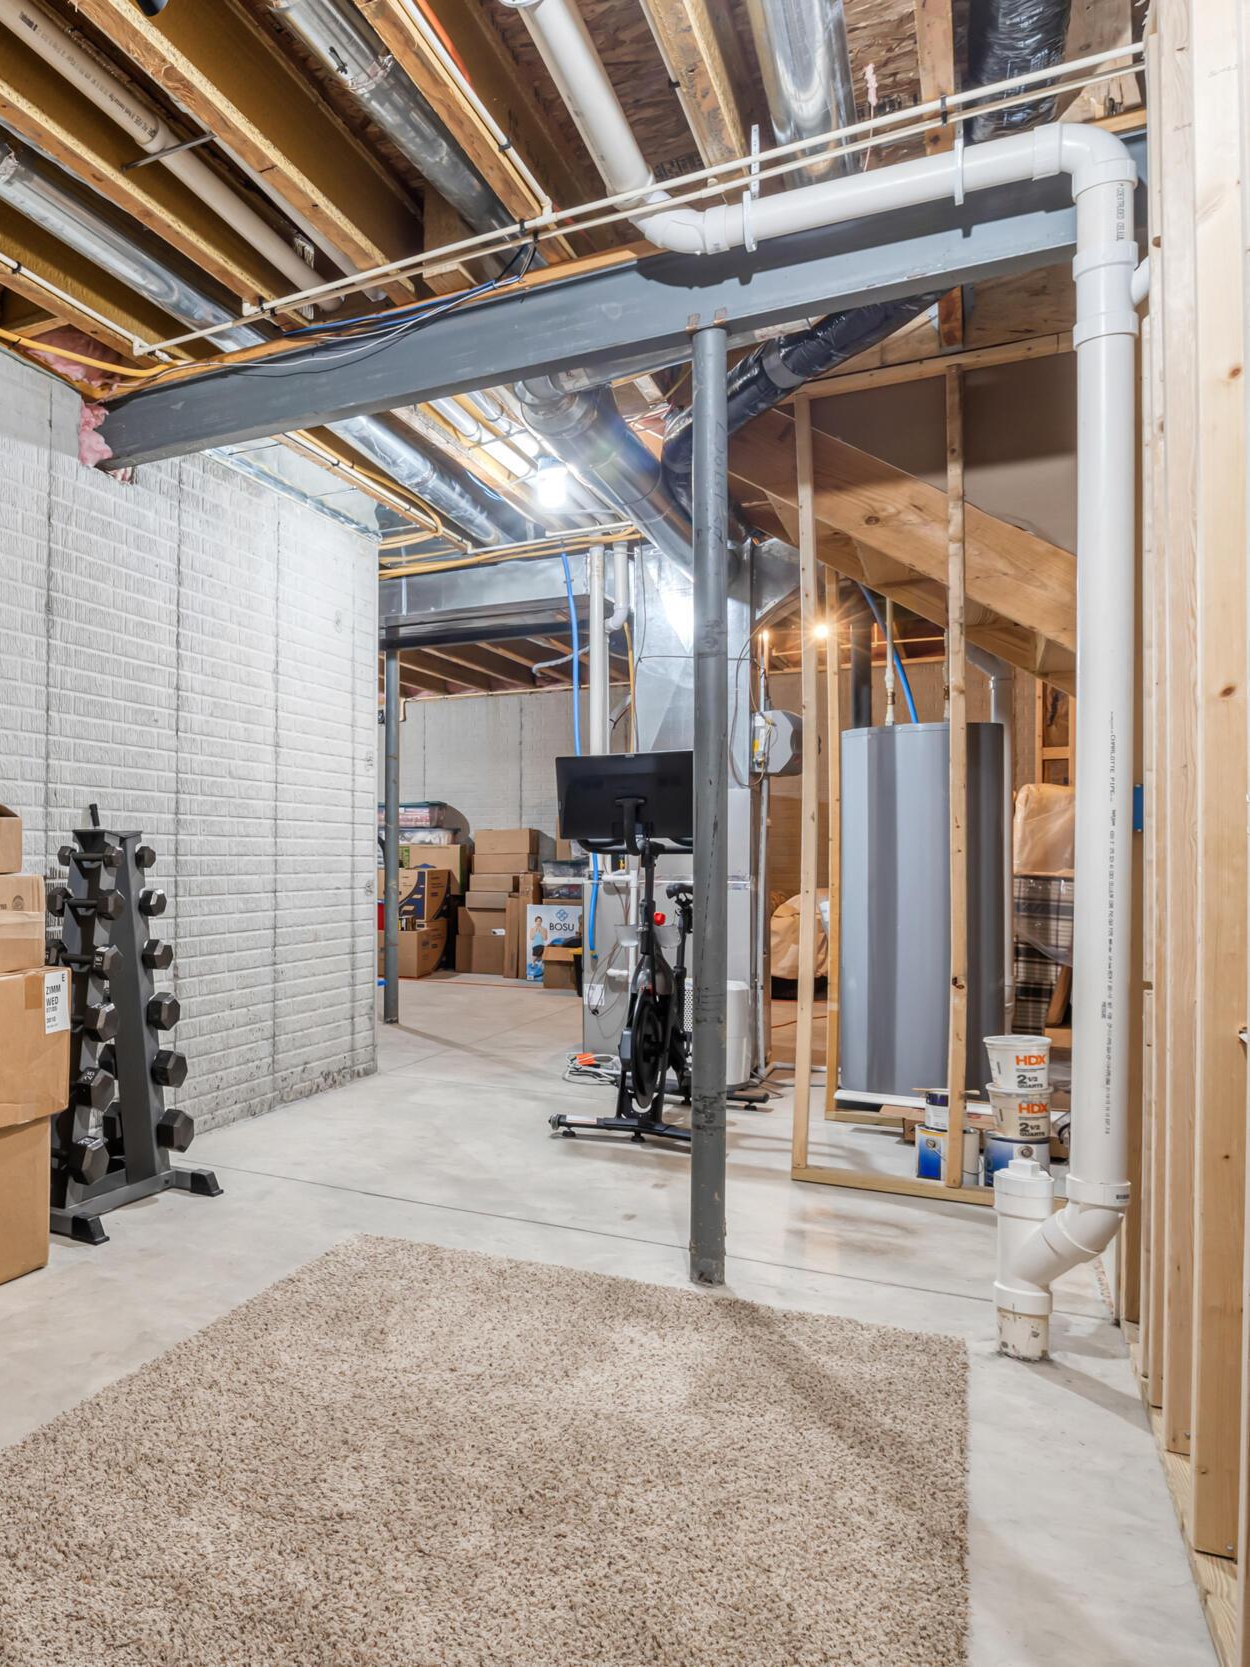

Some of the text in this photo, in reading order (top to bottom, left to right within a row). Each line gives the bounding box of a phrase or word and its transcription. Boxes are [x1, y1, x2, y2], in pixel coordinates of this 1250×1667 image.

[549, 922, 575, 932] BOSU
[1015, 1055, 1047, 1066] HDX
[1017, 1074, 1027, 1085] 2
[1018, 1103, 1048, 1114] HDX
[1019, 1123, 1029, 1133] 2
